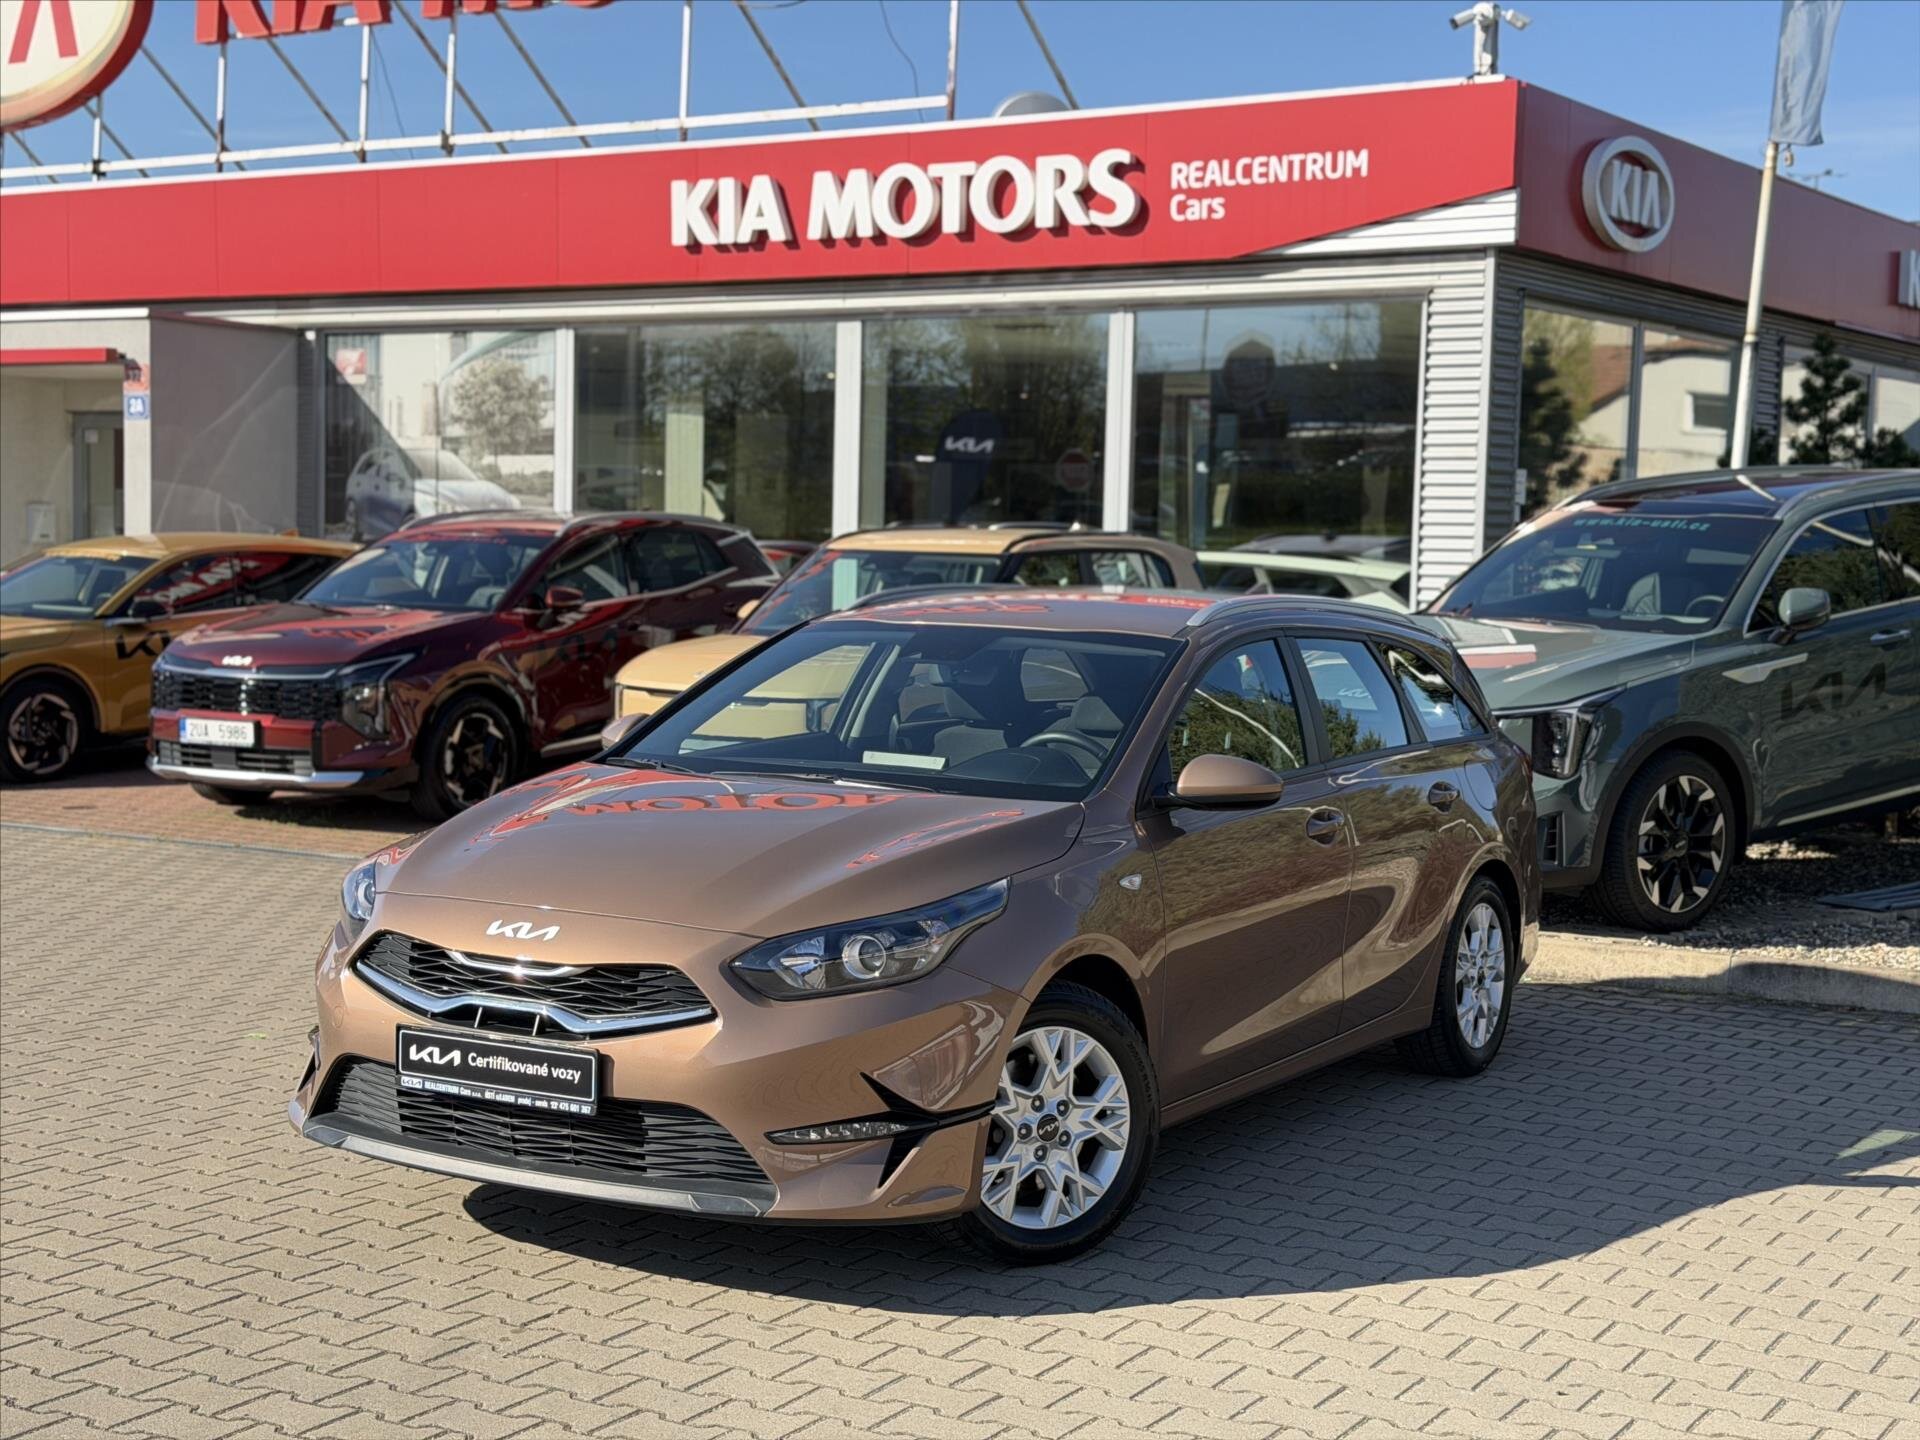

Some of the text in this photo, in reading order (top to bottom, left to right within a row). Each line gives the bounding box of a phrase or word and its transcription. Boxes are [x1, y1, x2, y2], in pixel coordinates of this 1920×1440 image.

[1170, 148, 1369, 190] REALCENTRUM
[671, 148, 1140, 247] KIA MOTORS
[1170, 194, 1226, 222] Cars
[1610, 159, 1661, 230] KIA
[945, 436, 995, 453] KIA
[486, 919, 561, 941] KIA
[409, 1043, 581, 1084] KIA Certifikované vozy
